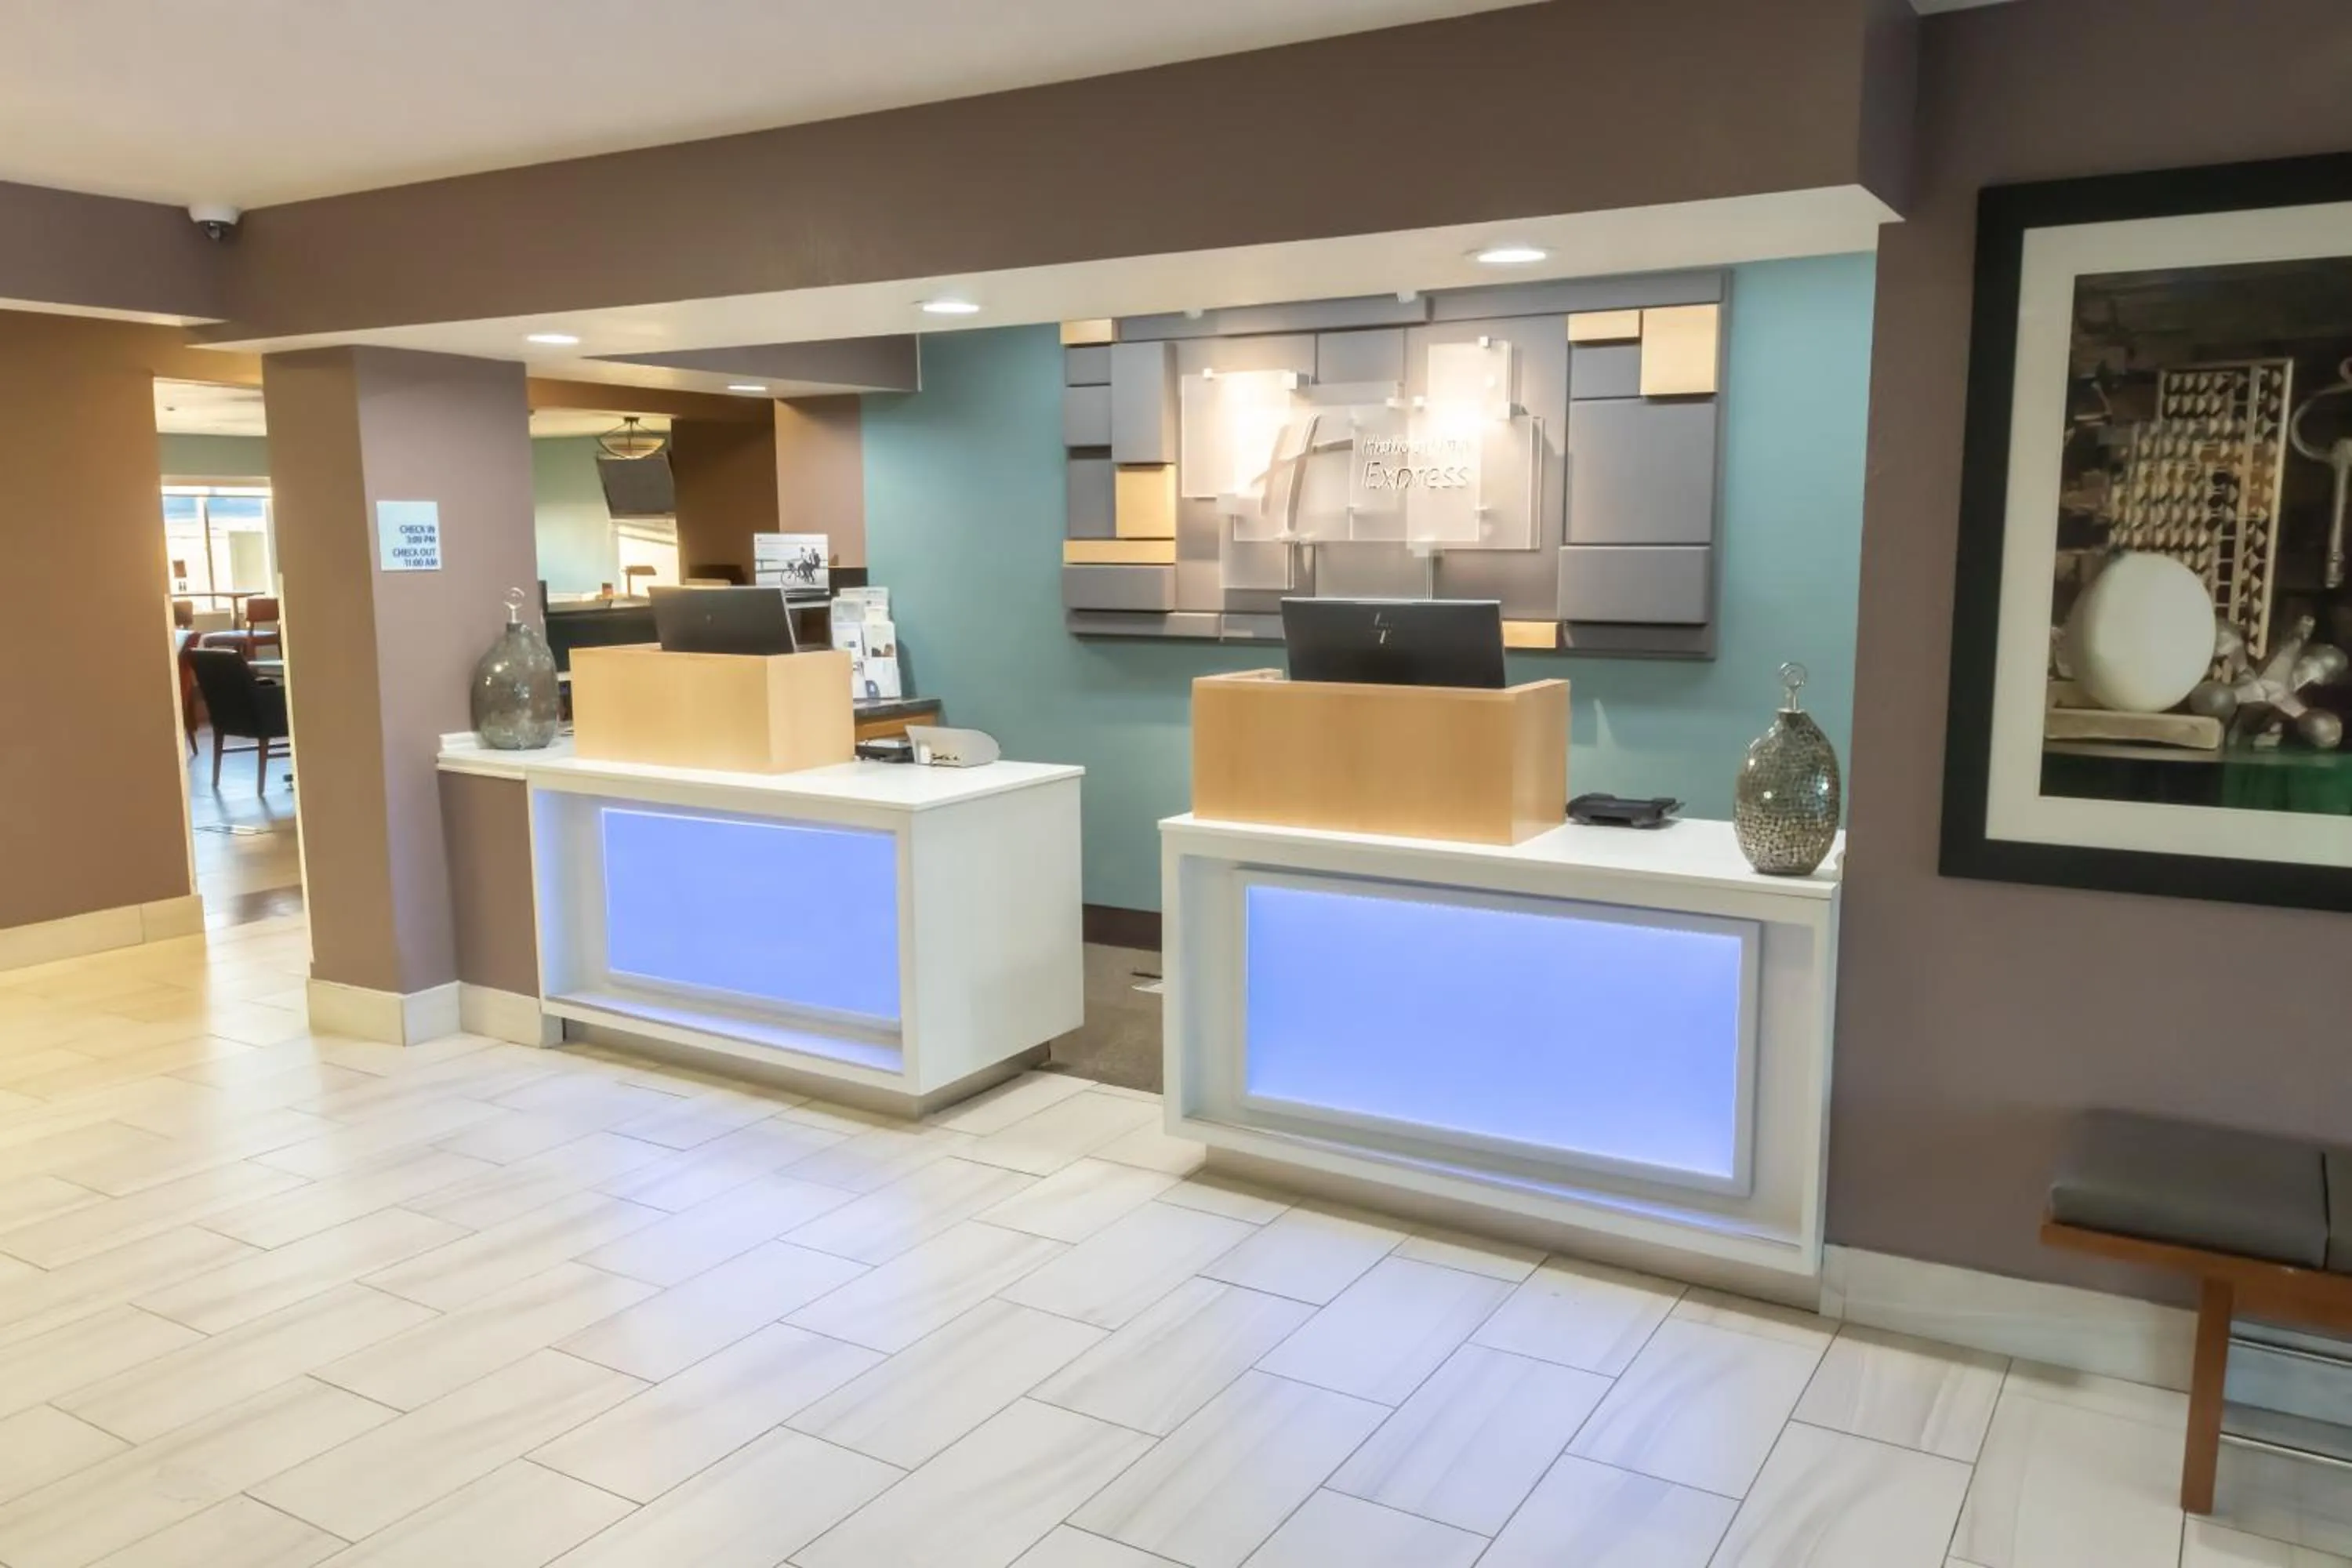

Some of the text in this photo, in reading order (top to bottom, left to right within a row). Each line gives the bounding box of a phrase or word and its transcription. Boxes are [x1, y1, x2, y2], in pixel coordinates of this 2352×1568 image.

[1362, 460, 1470, 490] Express
[399, 524, 436, 534] CHECK IN
[423, 535, 437, 543] PM
[392, 547, 437, 558] CHECK OUT
[425, 557, 438, 567] AM
